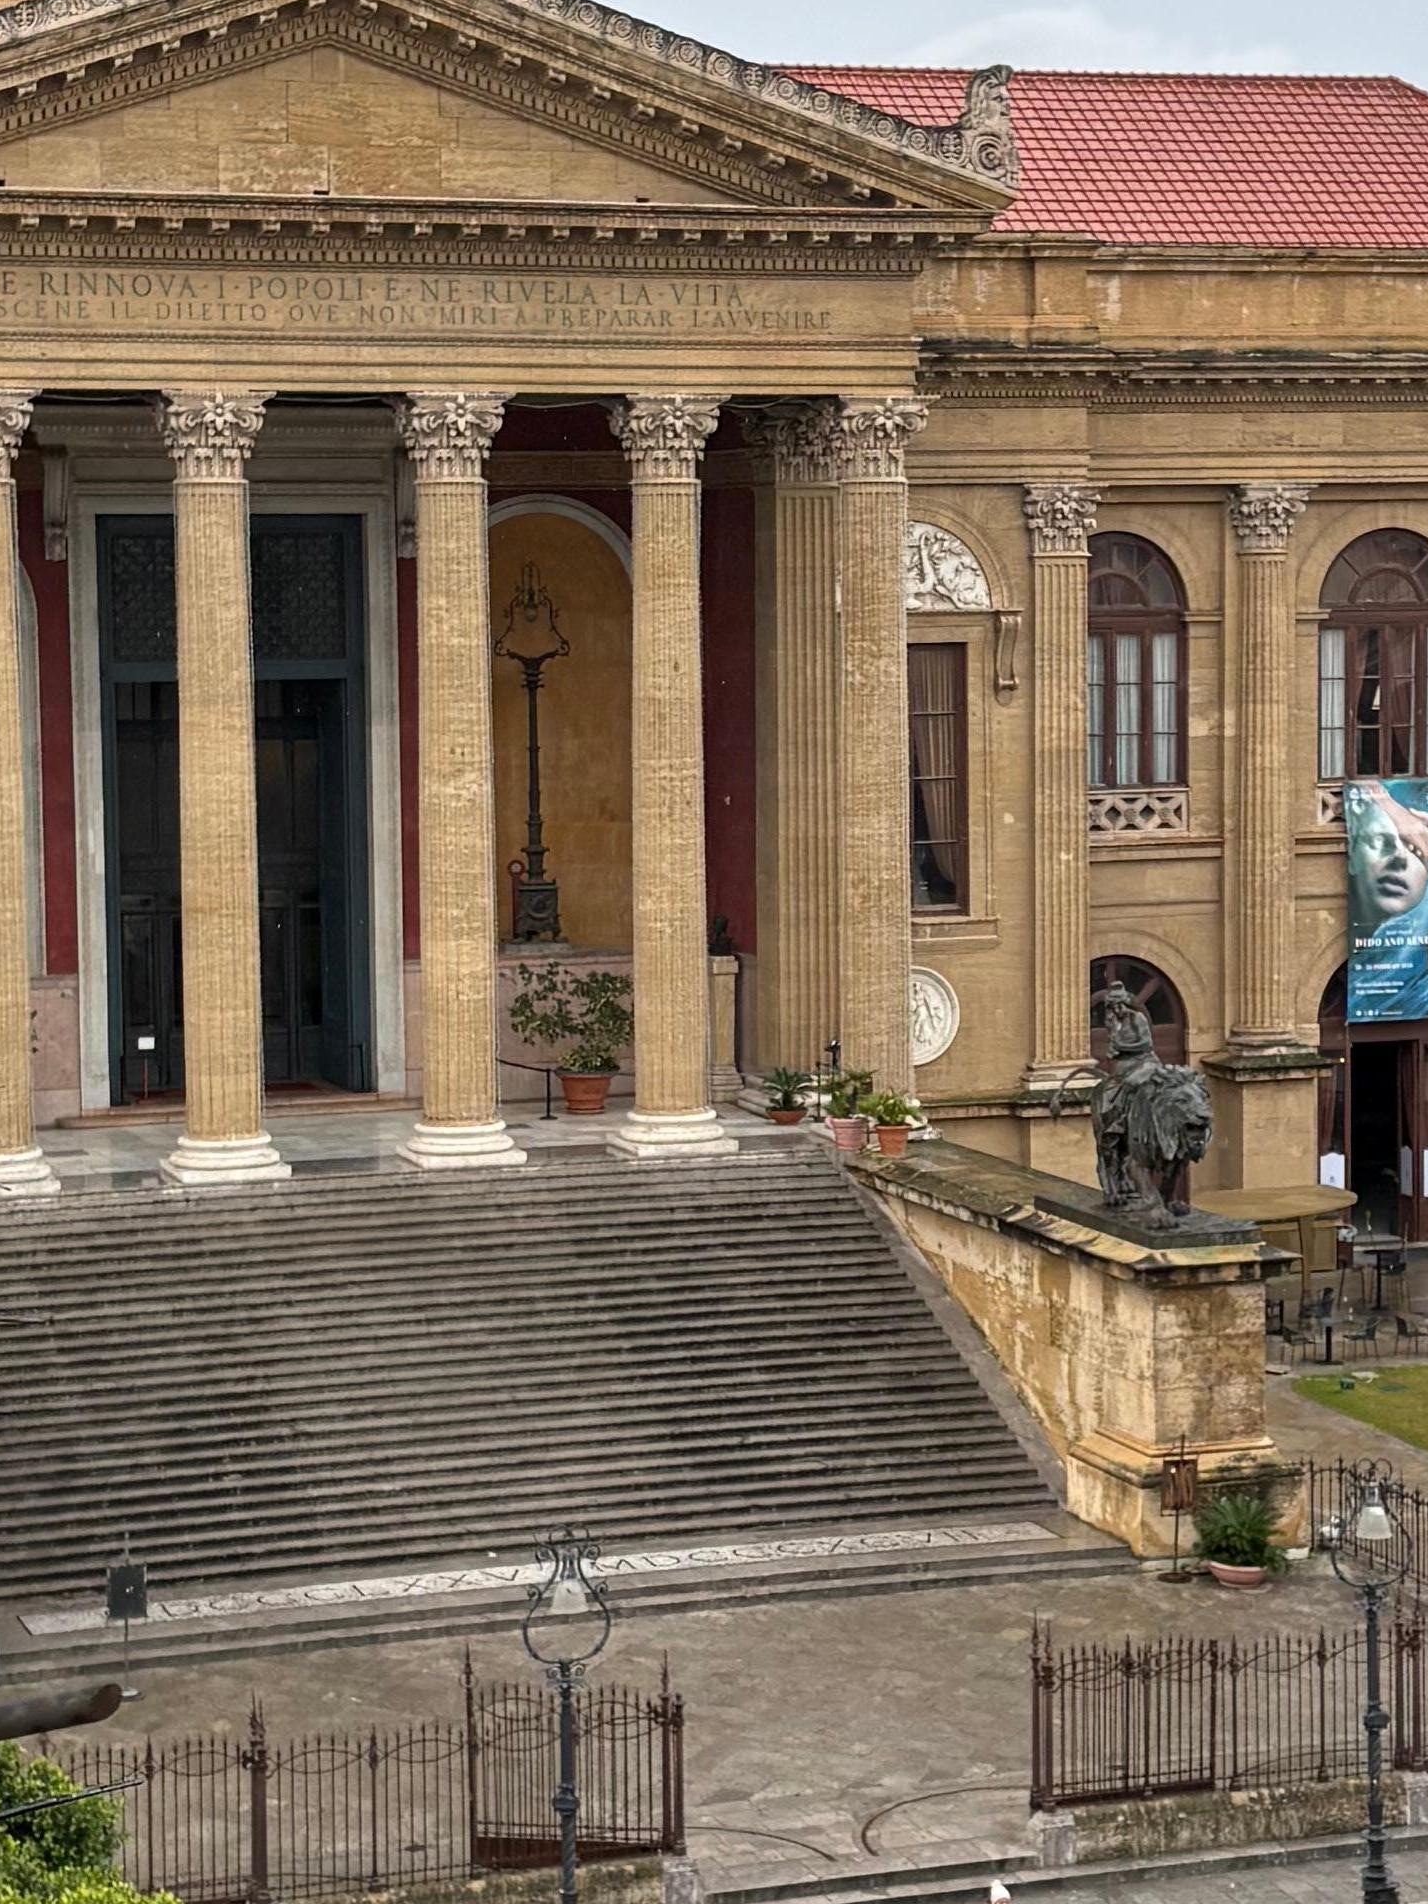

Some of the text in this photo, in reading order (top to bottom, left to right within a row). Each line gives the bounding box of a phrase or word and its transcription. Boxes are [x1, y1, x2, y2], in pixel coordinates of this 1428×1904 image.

[39, 271, 198, 298] RINNOVA
[217, 275, 226, 299] I
[248, 276, 364, 302] POPOLI
[384, 278, 401, 303] E
[421, 279, 462, 304] NE
[482, 280, 598, 306] RIVELA
[618, 282, 653, 306] LA
[671, 283, 745, 307] VITA
[109, 301, 137, 320] IL
[155, 302, 267, 322] DILETTO
[288, 304, 340, 323] OVE
[359, 305, 416, 325] NON
[439, 306, 498, 327] MIRI
[513, 307, 528, 327] A
[545, 307, 675, 329] PREPARAR
[691, 308, 832, 330] L'AVVENIRE
[1355, 937, 1382, 948] DIDO
[1384, 936, 1405, 947] AND
